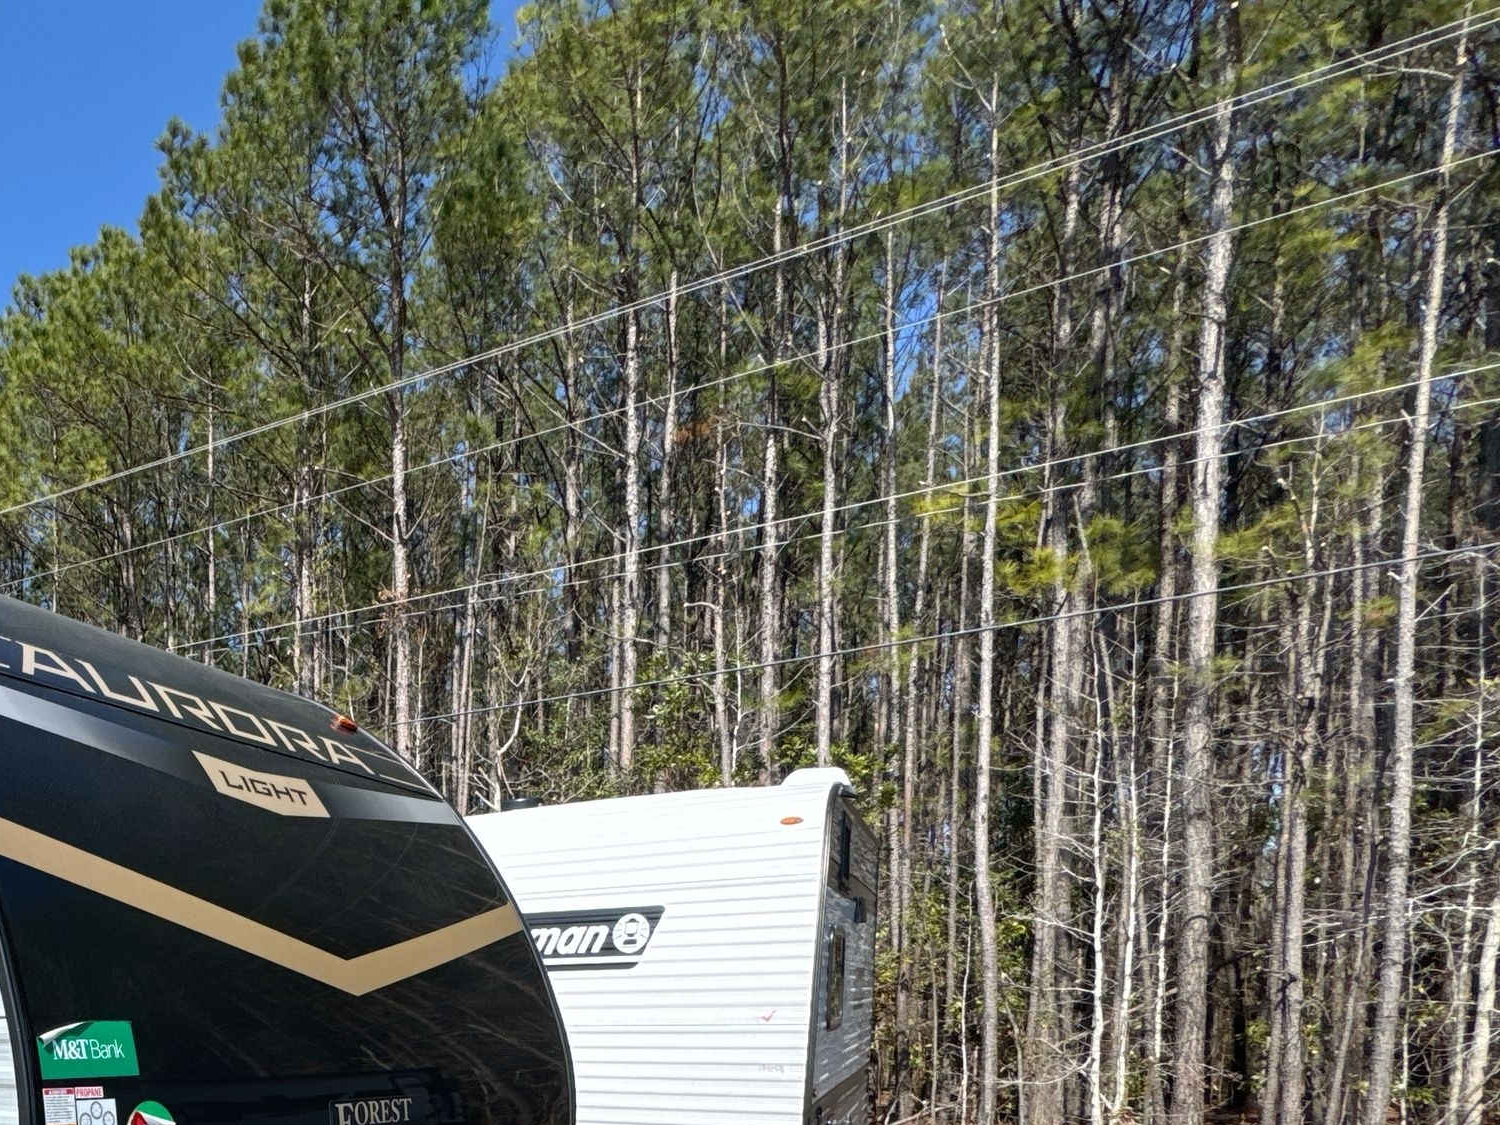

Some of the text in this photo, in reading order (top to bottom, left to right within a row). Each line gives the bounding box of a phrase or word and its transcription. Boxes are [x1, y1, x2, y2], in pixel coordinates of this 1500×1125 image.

[15, 640, 375, 775] AURORA
[218, 770, 308, 806] LIGHT
[52, 1039, 125, 1060] M&T Bank
[76, 1088, 102, 1097] PROPANE
